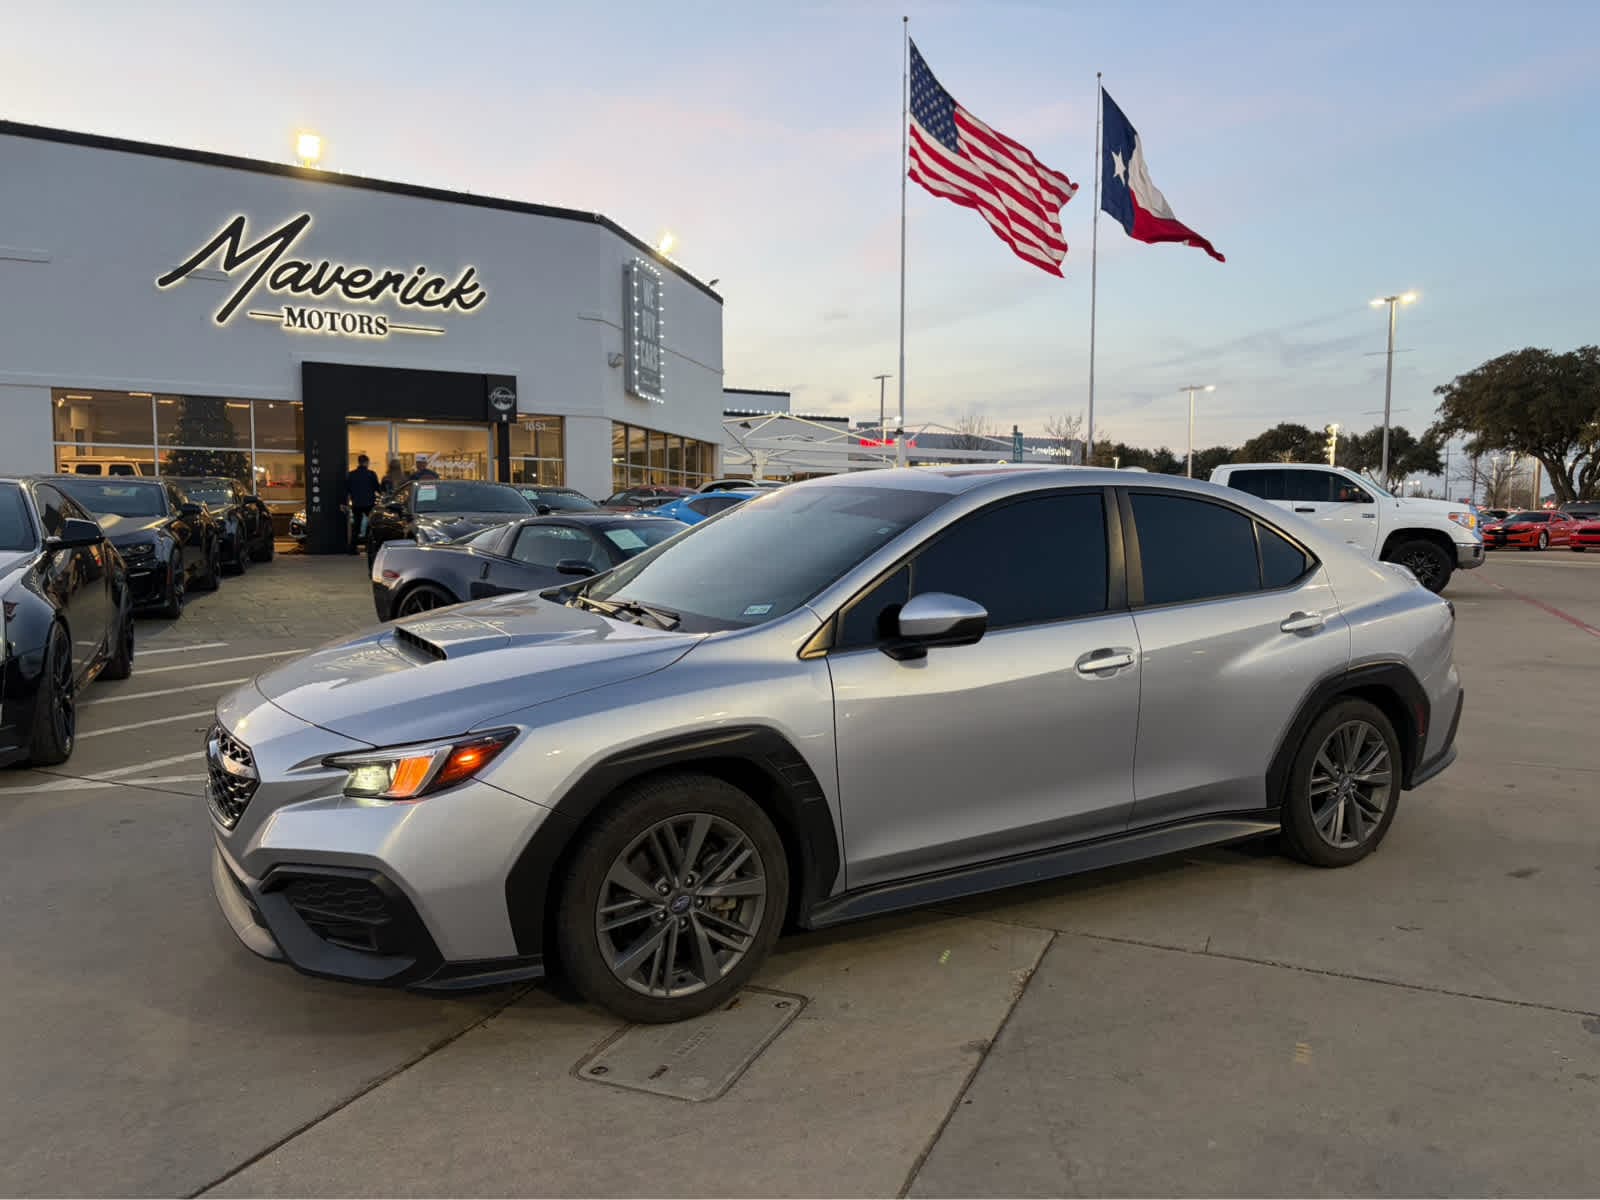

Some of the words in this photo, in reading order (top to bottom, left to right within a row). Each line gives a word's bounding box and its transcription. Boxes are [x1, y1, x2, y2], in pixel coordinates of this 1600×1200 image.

[158, 213, 486, 323] Maverick
[283, 306, 389, 336] MOTORS
[311, 440, 321, 513] HOWROOM
